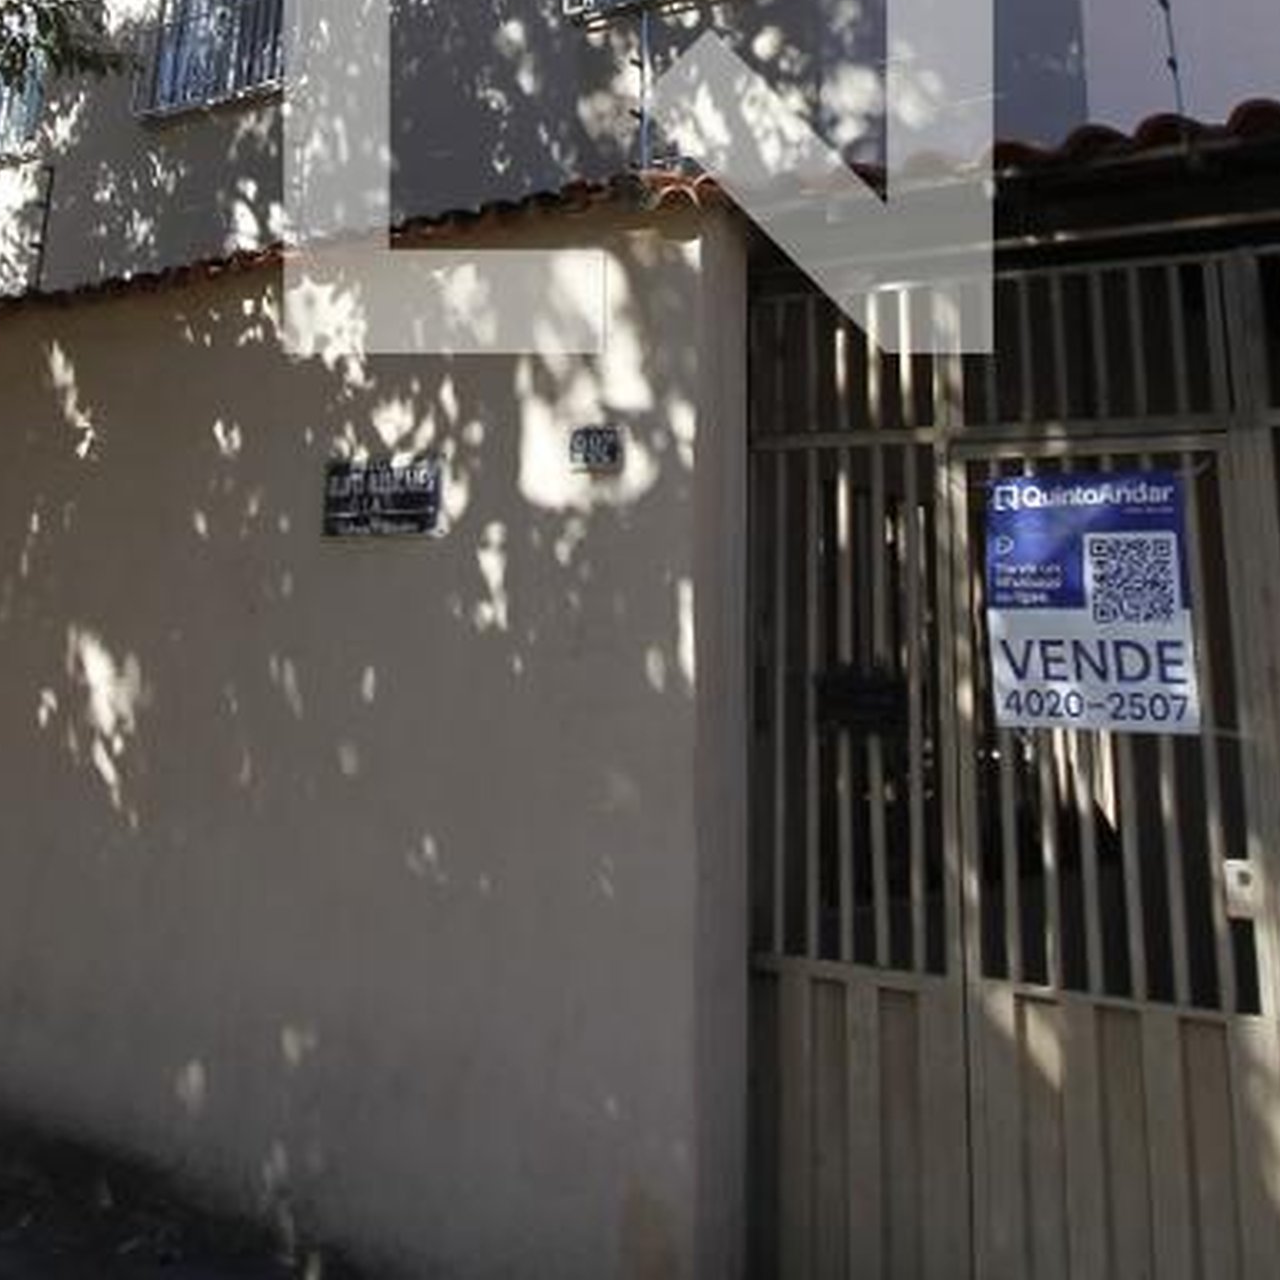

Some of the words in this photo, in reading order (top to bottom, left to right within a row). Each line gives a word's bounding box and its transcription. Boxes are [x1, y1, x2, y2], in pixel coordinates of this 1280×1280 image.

[1022, 482, 1174, 508] QuintoAndar
[1000, 639, 1187, 684] VENDE
[1005, 689, 1188, 721] 4020-2507
